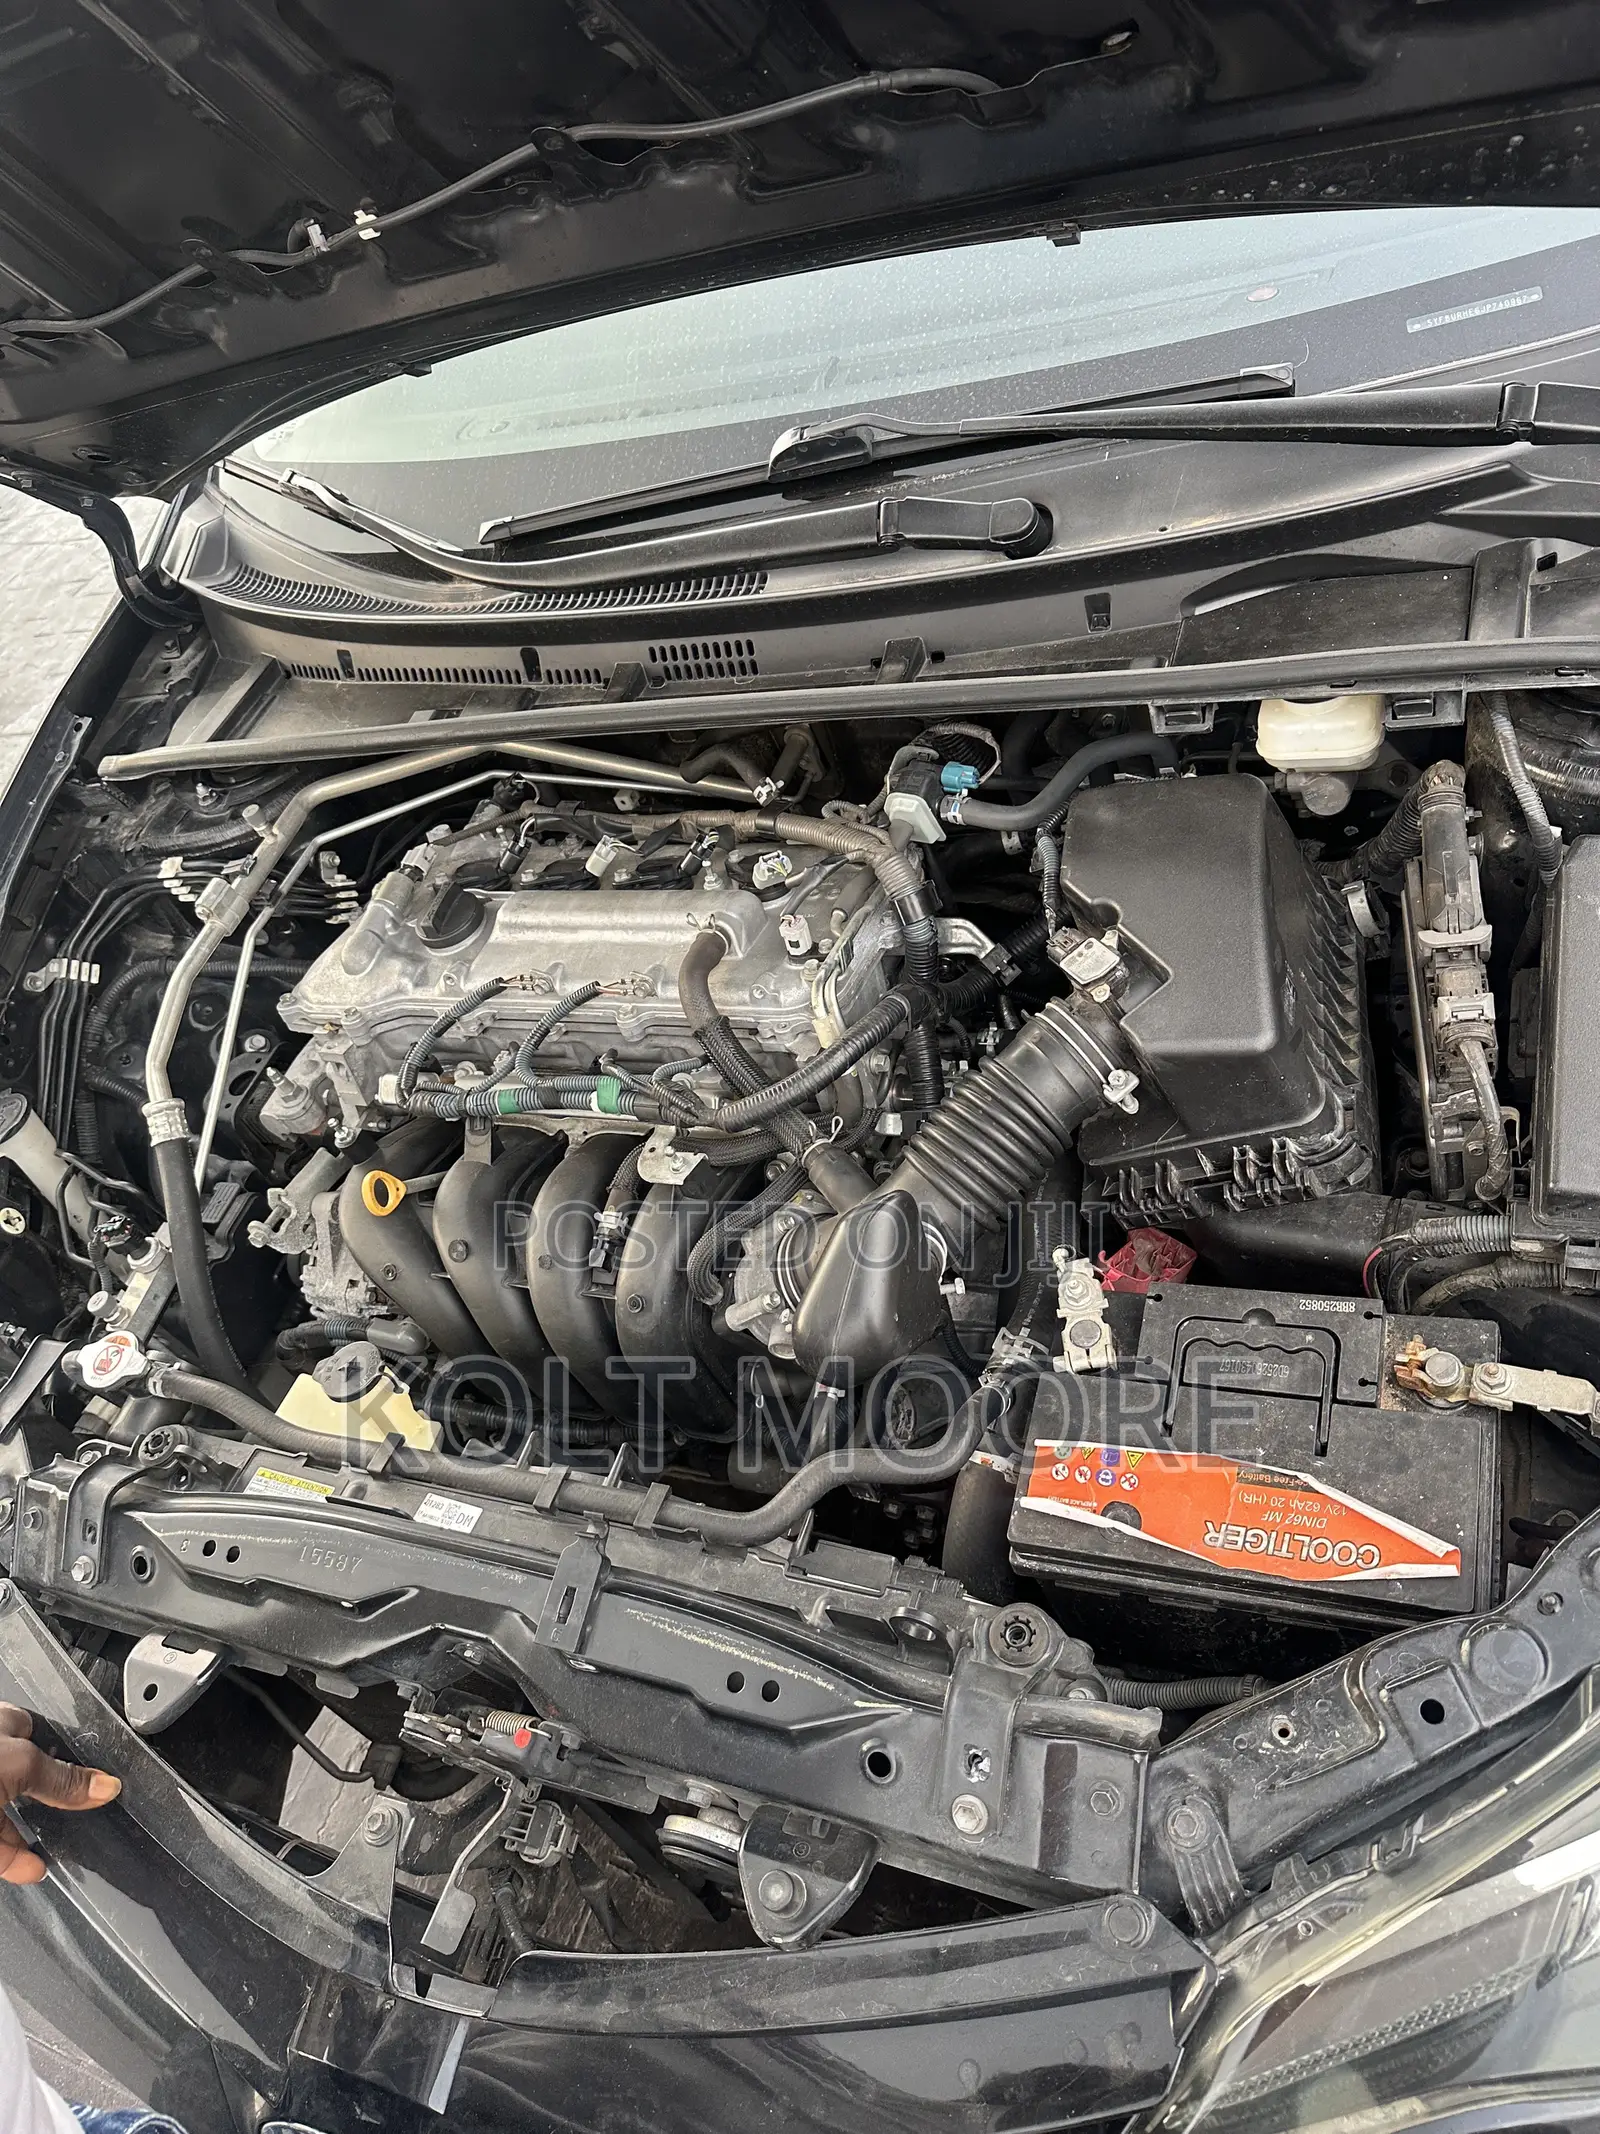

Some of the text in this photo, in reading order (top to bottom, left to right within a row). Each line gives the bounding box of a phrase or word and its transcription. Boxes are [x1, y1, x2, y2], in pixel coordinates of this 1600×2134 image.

[1300, 1299, 1356, 1313] 8BB250852
[1238, 1469, 1271, 1483] Battery
[1238, 1490, 1348, 1516] 12V 62Ah 20 (HR)
[455, 1512, 474, 1527] DM
[1261, 1510, 1328, 1529] DIN62 MF
[1202, 1520, 1382, 1570] COOLTIGER
